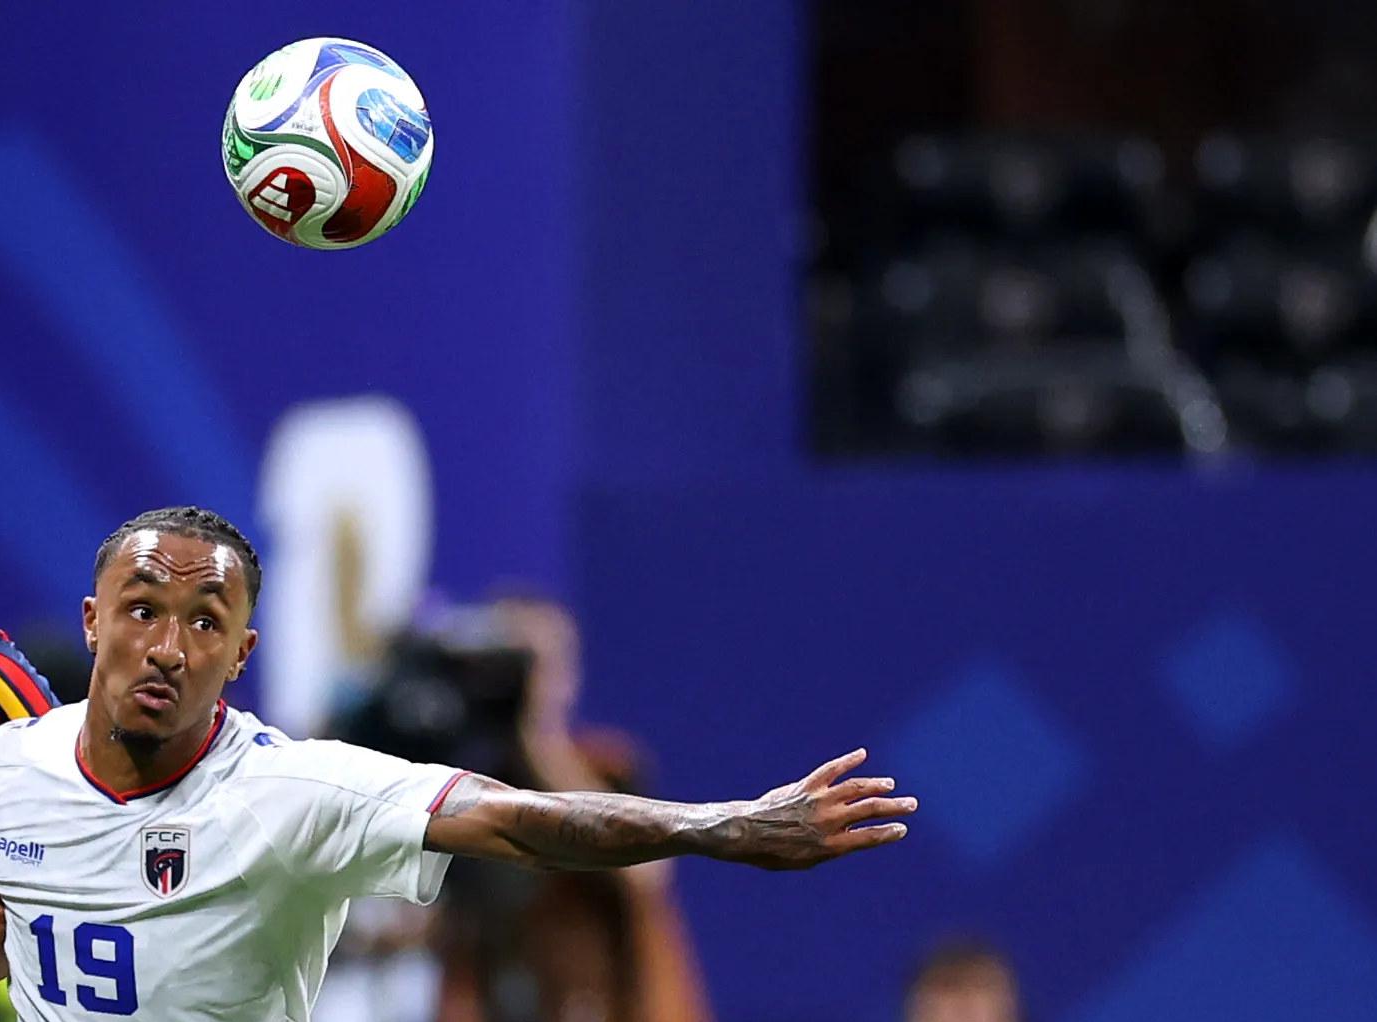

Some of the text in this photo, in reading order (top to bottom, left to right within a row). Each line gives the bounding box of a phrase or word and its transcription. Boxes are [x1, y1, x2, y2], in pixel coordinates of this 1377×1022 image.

[145, 831, 186, 842] FCF
[9, 854, 42, 867] SPORT
[29, 914, 139, 1016] 19
